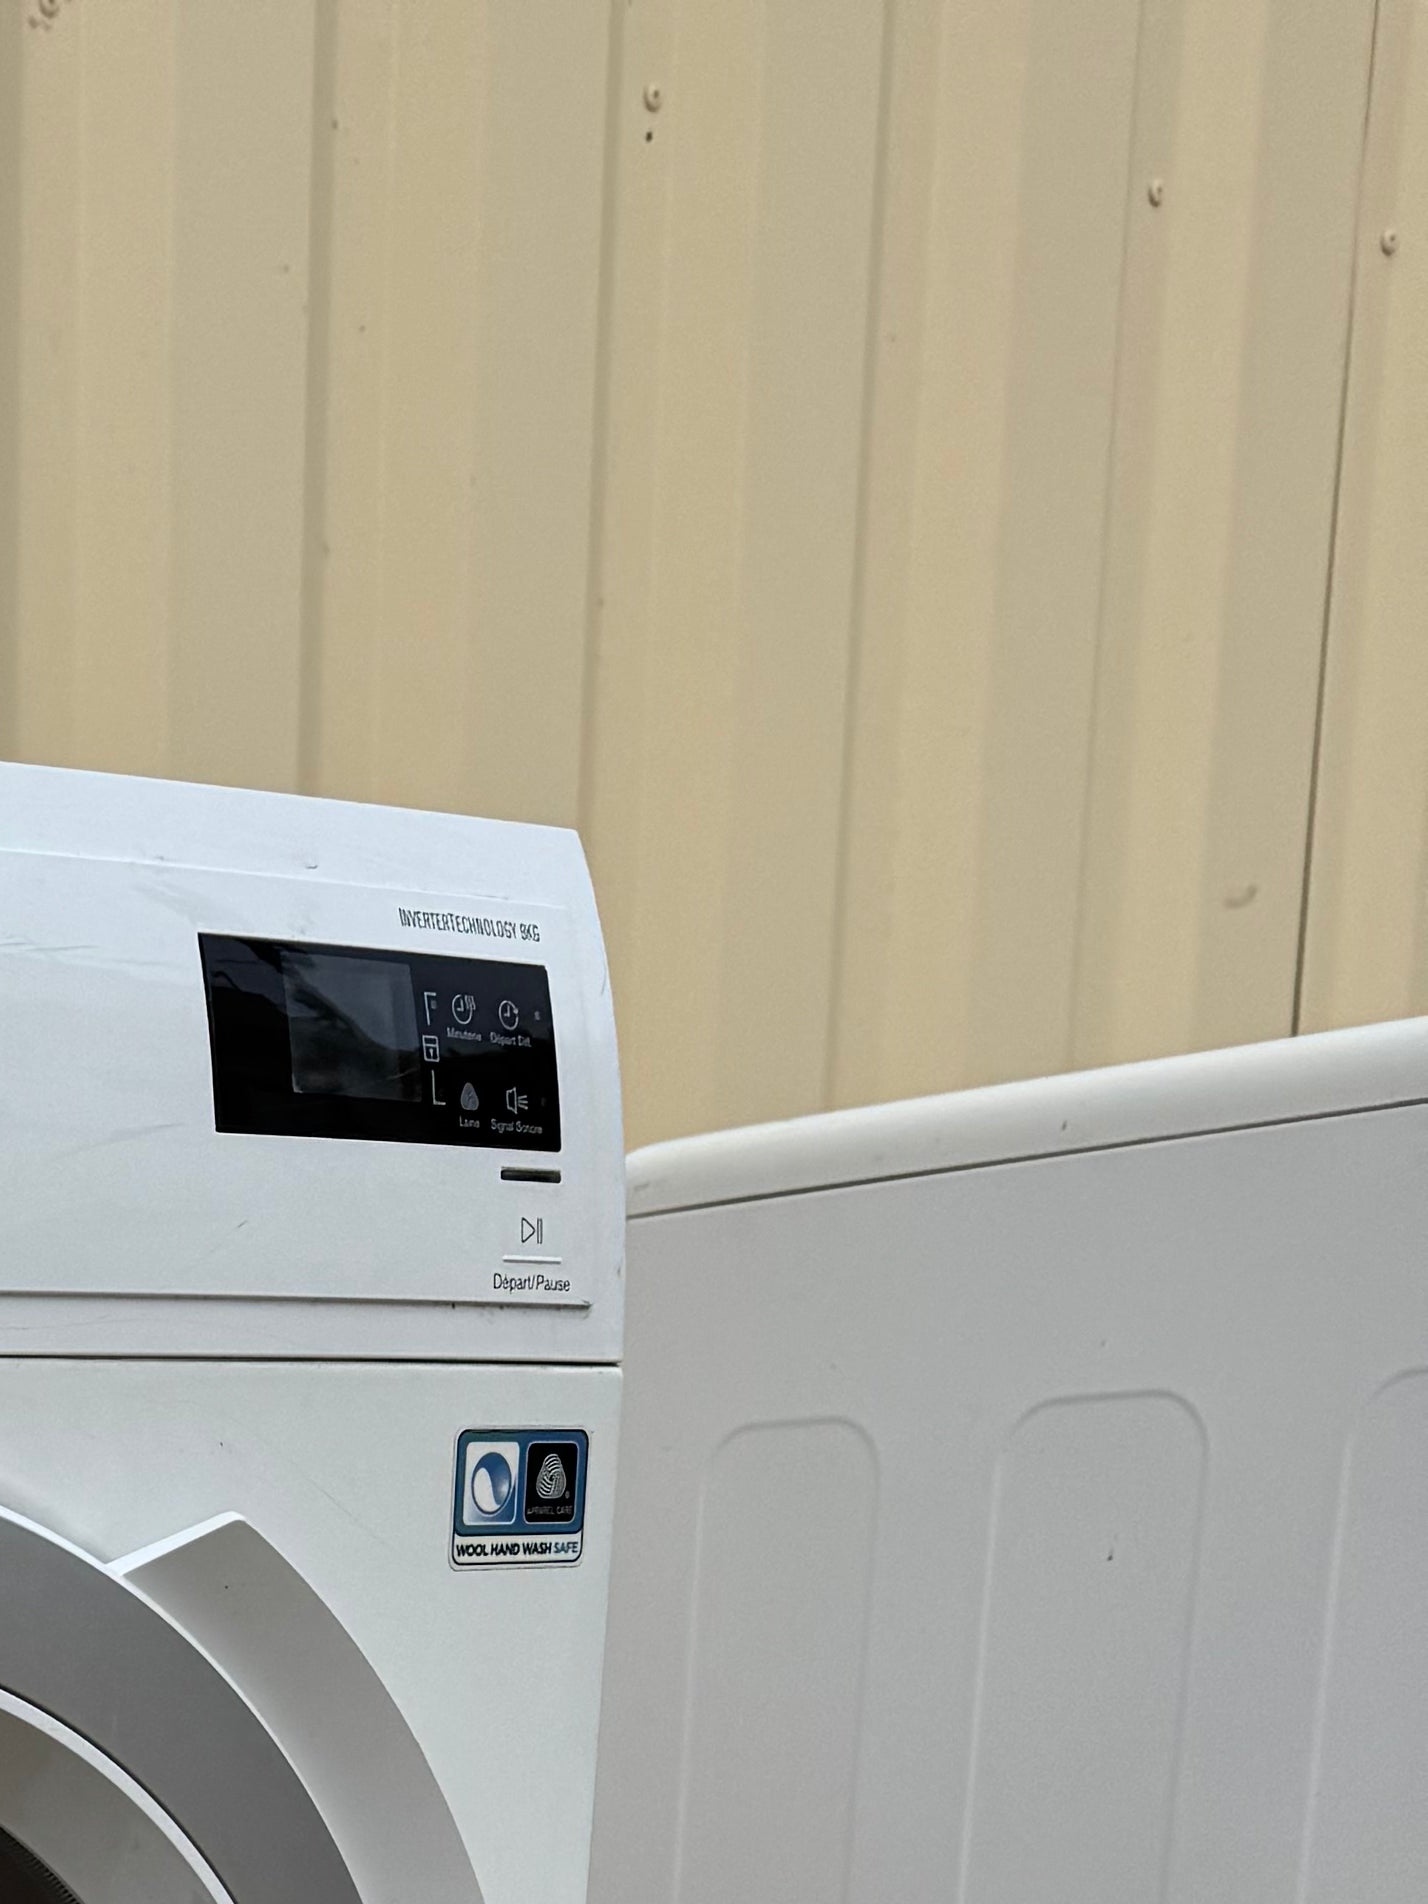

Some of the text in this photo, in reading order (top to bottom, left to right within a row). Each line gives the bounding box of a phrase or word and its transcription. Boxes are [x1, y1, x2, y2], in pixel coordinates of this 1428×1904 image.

[398, 907, 518, 940] INVERTERTECHNOLOGY
[492, 1271, 572, 1295] Départ/Pause
[455, 1540, 579, 1558] WOOL HAND WASH SAFE
